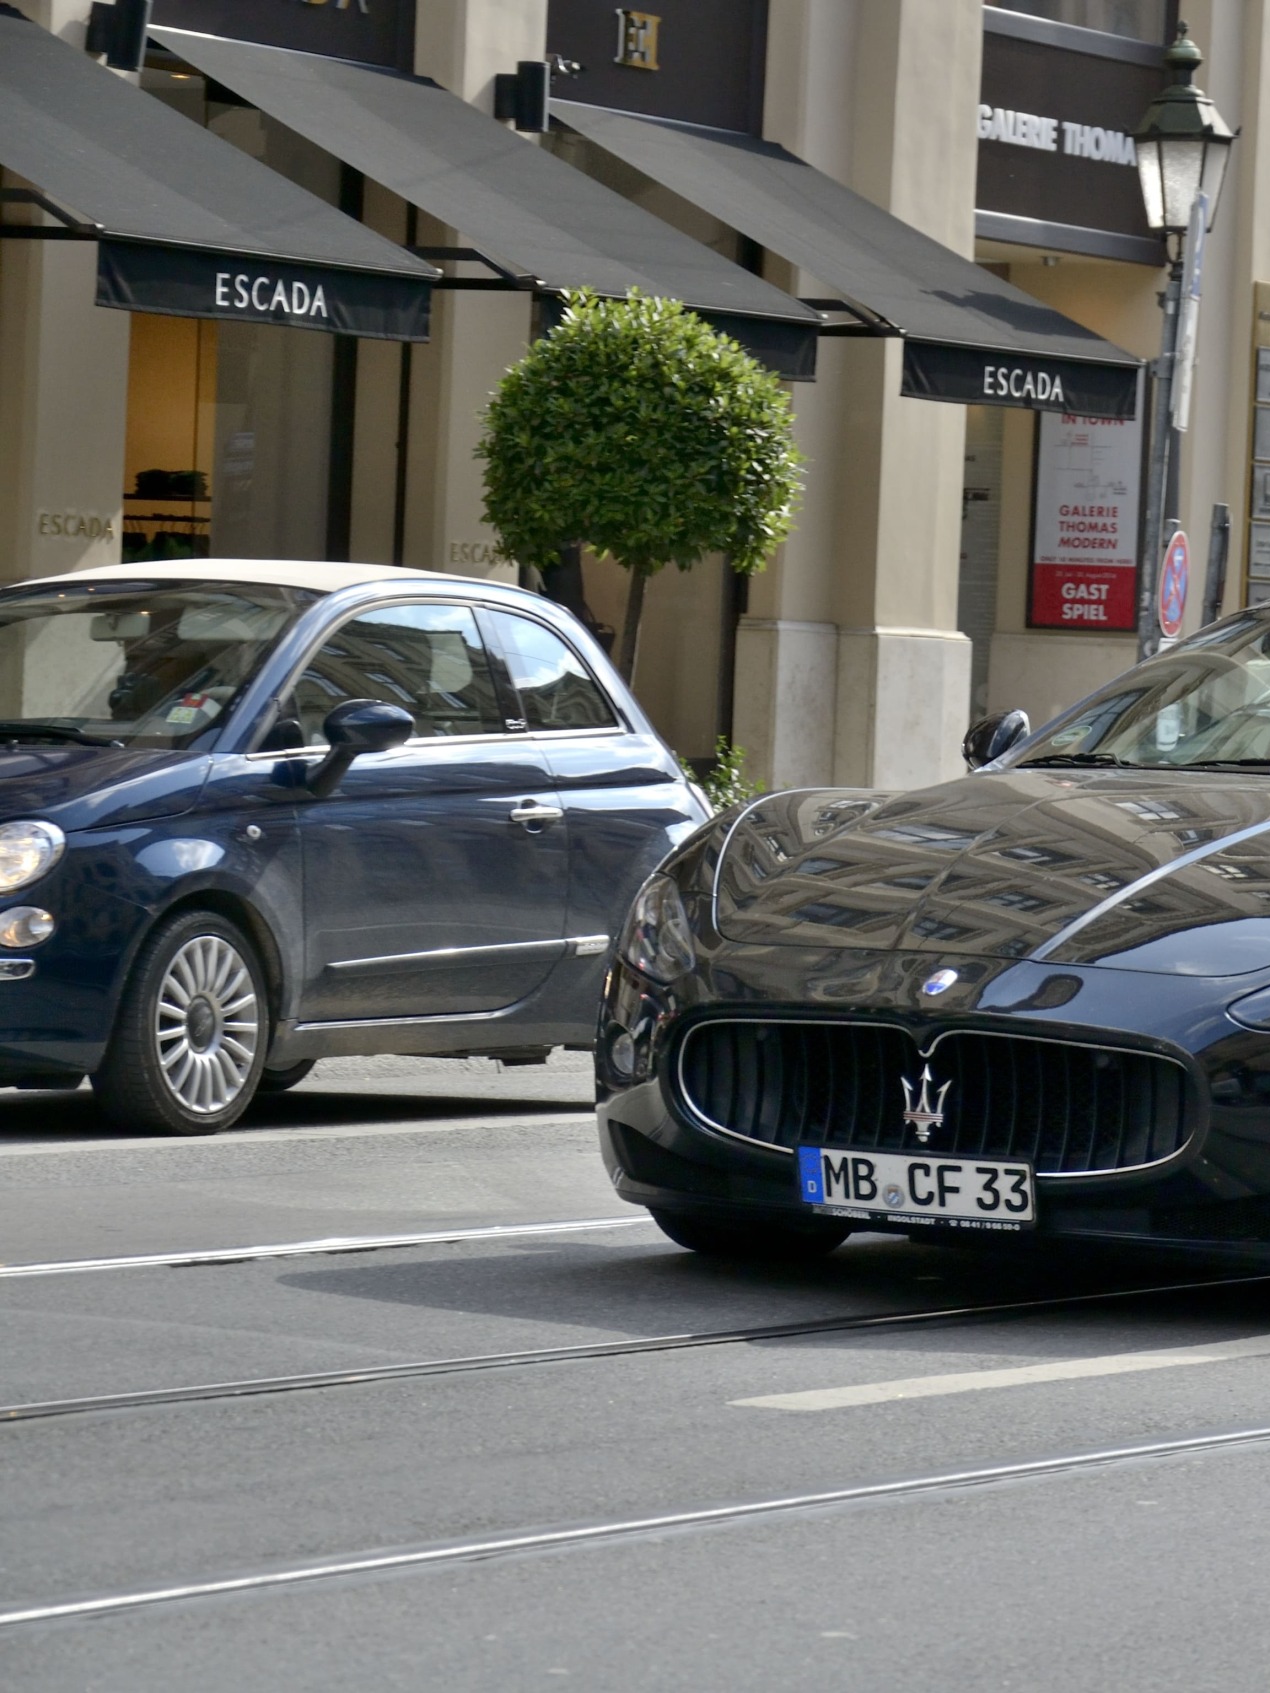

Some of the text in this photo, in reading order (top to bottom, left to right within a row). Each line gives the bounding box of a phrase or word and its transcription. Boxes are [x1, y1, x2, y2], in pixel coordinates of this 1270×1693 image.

[977, 104, 1058, 151] GALERIE
[215, 272, 328, 317] ESCADA
[984, 366, 1064, 402] ESCADA
[1059, 505, 1118, 517] GALERIE
[39, 513, 114, 544] ESCADA
[1058, 521, 1117, 533] THOMAS
[1057, 537, 1117, 549] MODERN
[1061, 582, 1109, 600] GAST
[1062, 603, 1108, 620] SPIEL
[807, 1180, 817, 1193] D
[823, 1154, 1028, 1213] MB CF 33
[887, 1215, 936, 1226] INGOLSTADT
